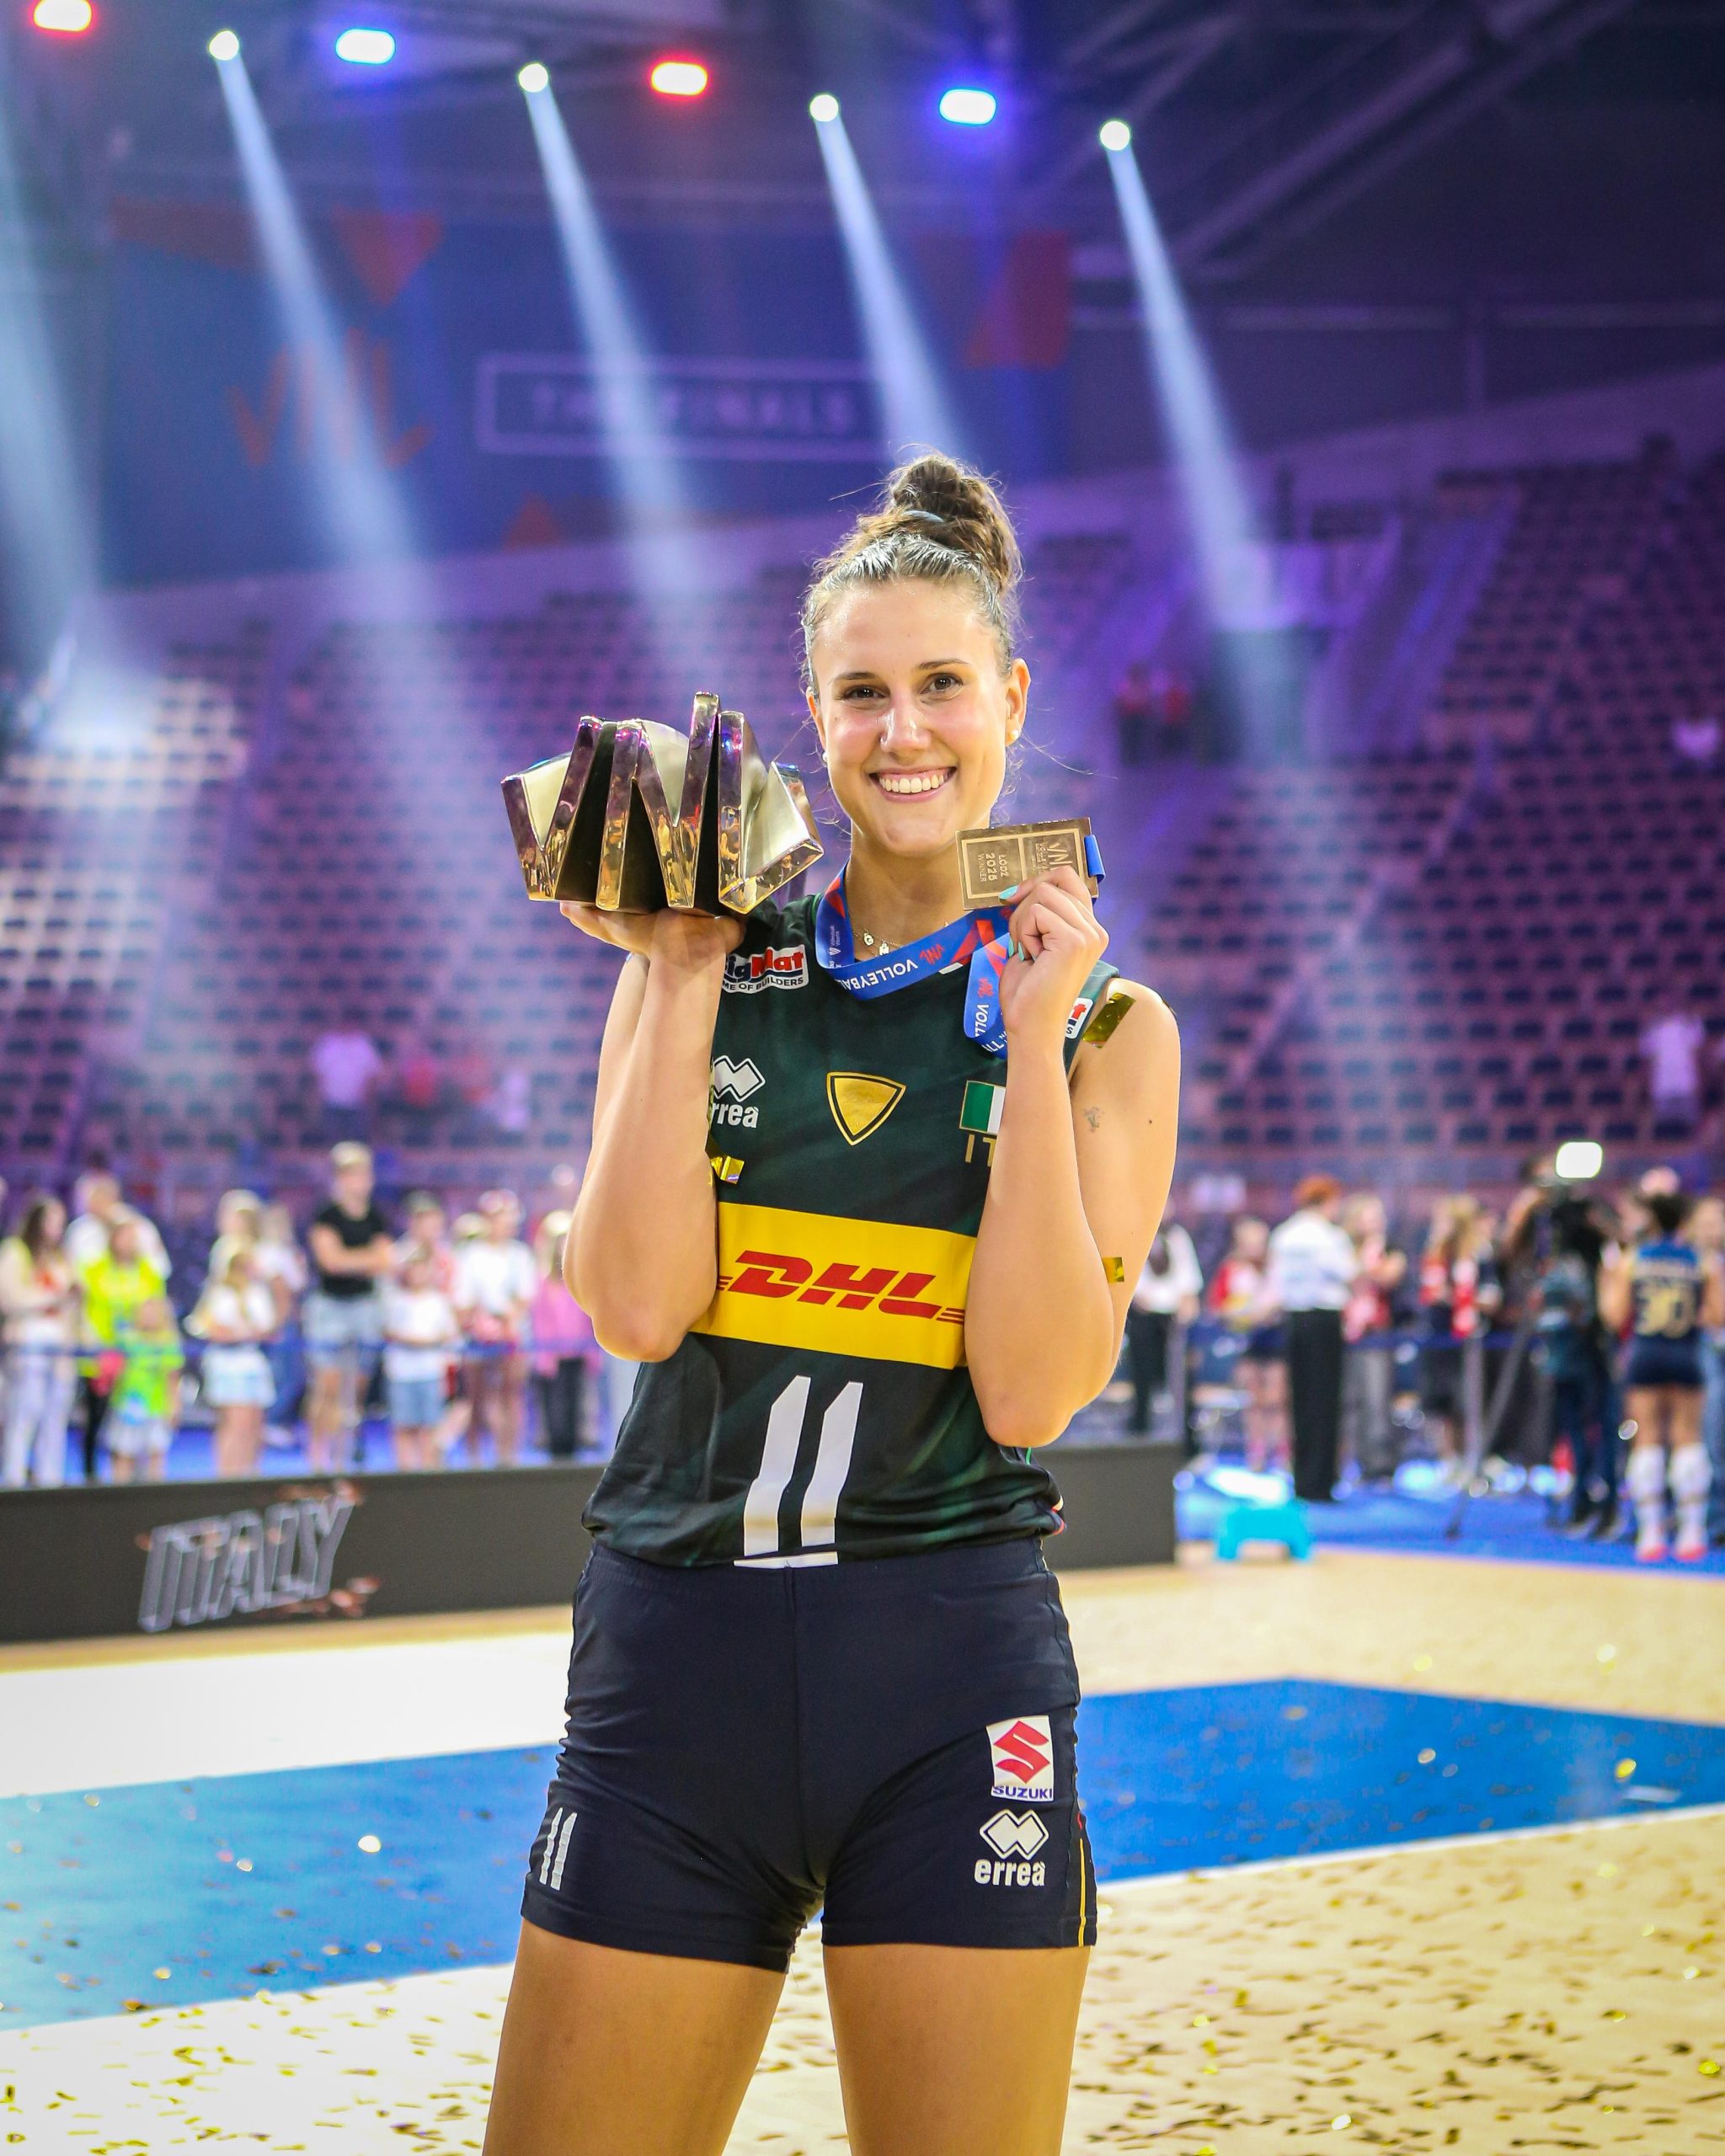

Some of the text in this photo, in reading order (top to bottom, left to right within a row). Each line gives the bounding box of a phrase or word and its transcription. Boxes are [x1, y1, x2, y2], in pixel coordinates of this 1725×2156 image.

[723, 979, 736, 990] ME
[756, 976, 804, 990] BUILDERS
[725, 949, 804, 981] igMat
[728, 1250, 943, 1319] DHL
[744, 1374, 864, 1556] 11
[992, 1785, 1053, 1800] SUZUKI
[539, 1806, 578, 1892] 11
